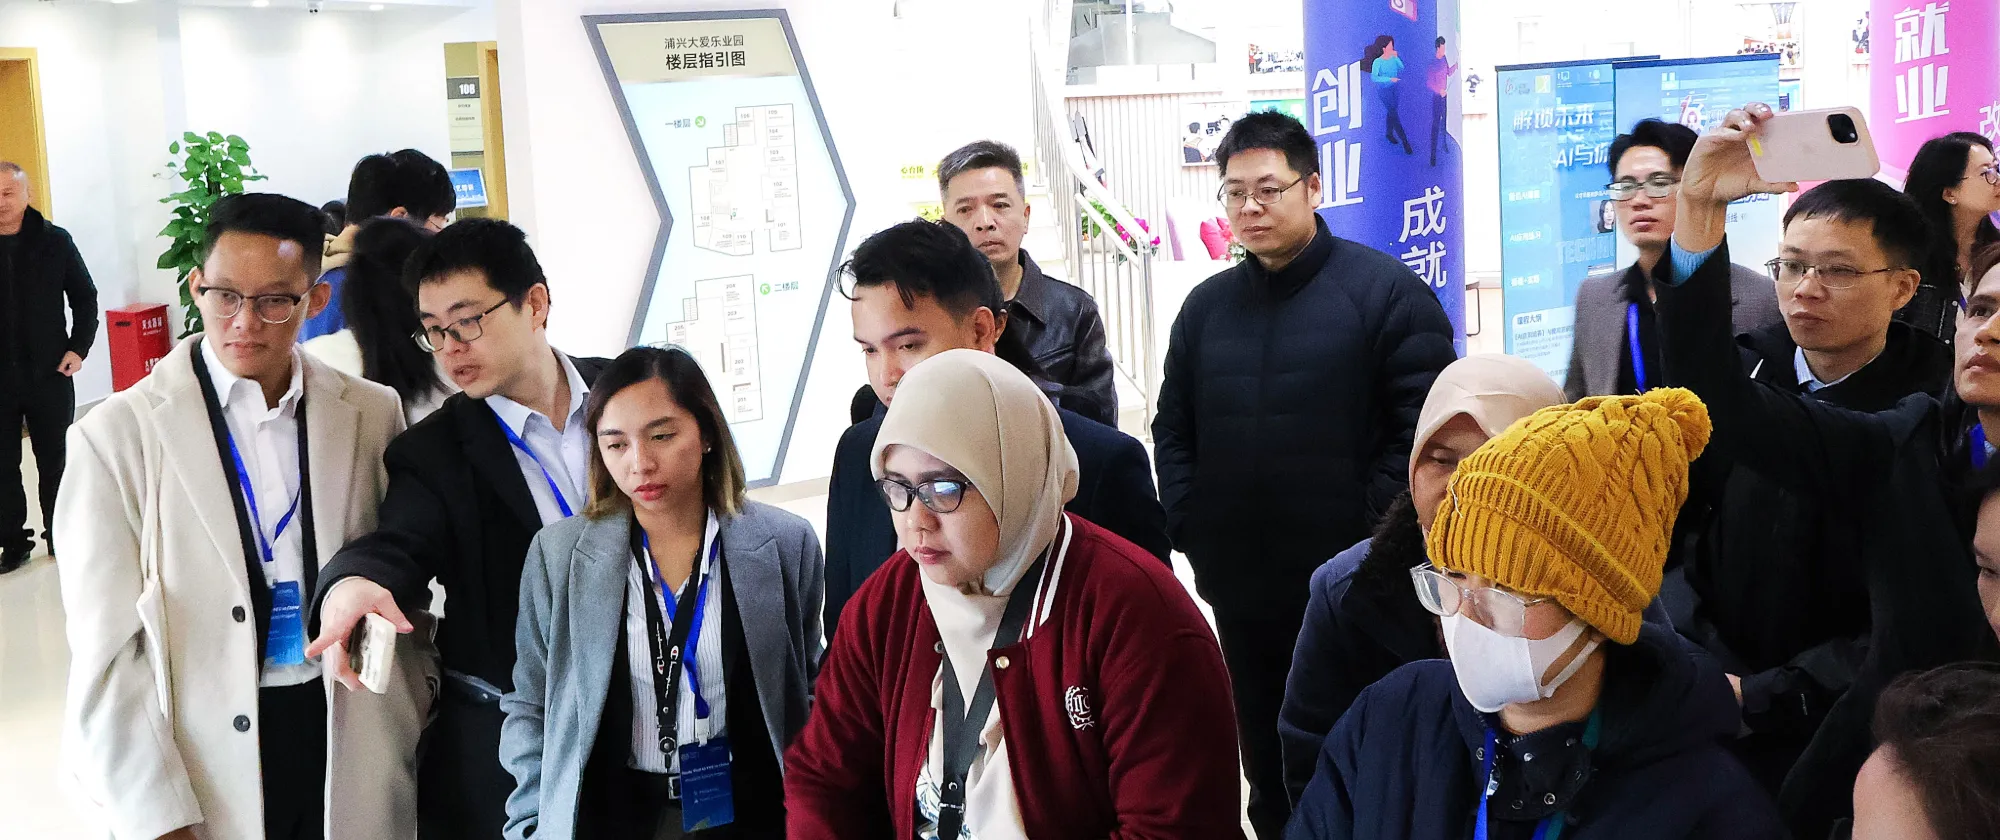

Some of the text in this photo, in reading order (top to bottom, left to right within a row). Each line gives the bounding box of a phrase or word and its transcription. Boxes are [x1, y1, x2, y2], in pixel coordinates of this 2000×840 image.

[664, 35, 744, 49] 浦兴大爱乐业园
[665, 51, 746, 70] 楼层指引图
[1894, 1, 1950, 124] 就业
[459, 84, 476, 95] 108
[665, 118, 691, 128] 一楼层
[1513, 104, 1595, 129] 解锁未来
[1312, 60, 1364, 210] 创业
[1399, 185, 1447, 288] 成就
[774, 281, 799, 292] 二楼层
